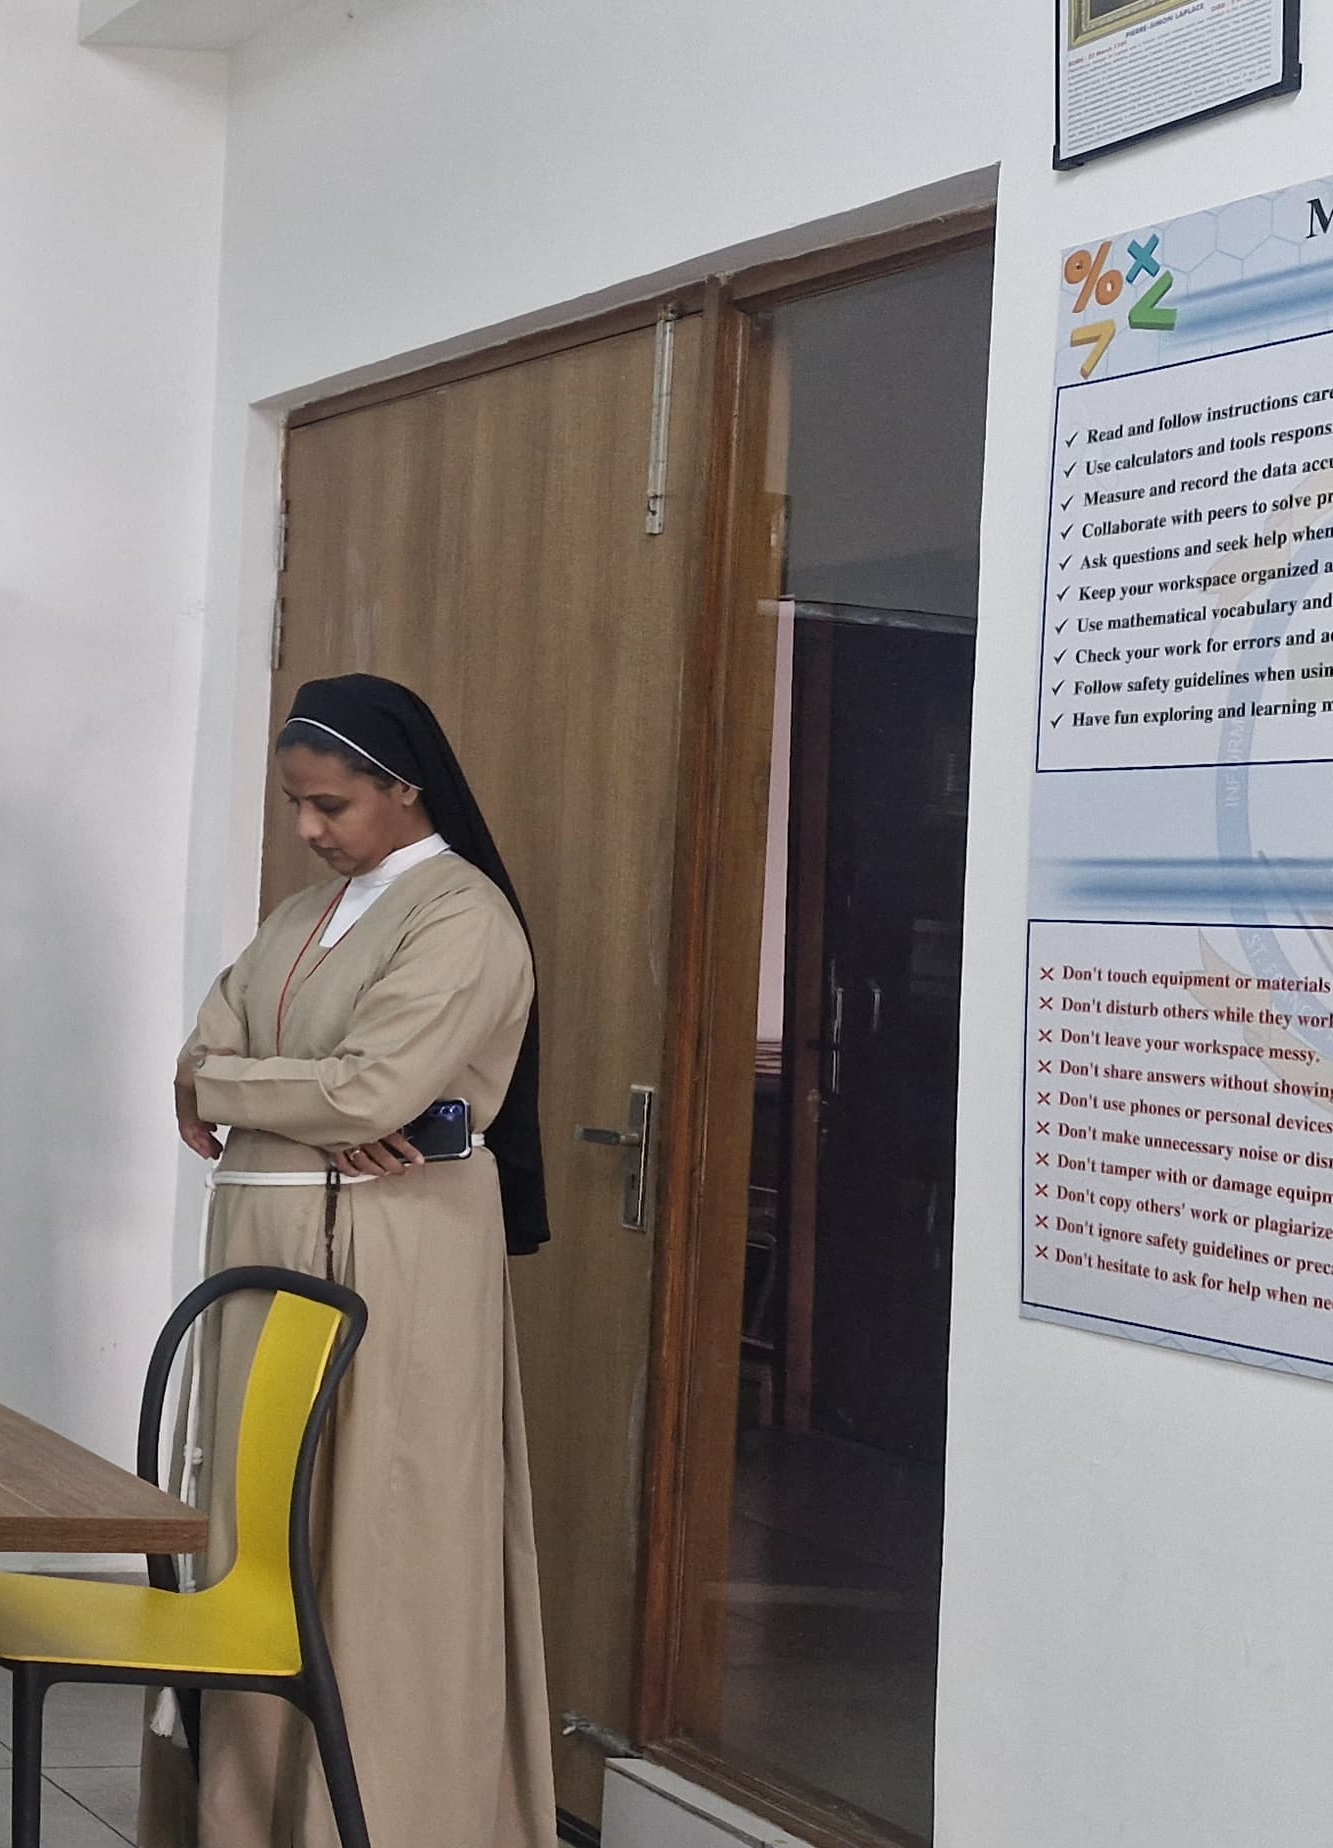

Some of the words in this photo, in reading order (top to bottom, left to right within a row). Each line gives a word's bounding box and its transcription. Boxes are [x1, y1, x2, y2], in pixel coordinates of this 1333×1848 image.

[1086, 424, 1124, 445] Read
[1127, 417, 1155, 437] and
[1157, 412, 1203, 432] follow
[1206, 394, 1299, 423] instructions
[1085, 459, 1112, 476] Use
[1114, 447, 1194, 471] calculators
[1196, 437, 1226, 457] and
[1229, 431, 1267, 452] tools
[1083, 488, 1146, 507] Measure
[1148, 478, 1176, 498] and
[1180, 470, 1229, 493] record
[1233, 467, 1258, 484] the
[1261, 461, 1298, 479] data
[1081, 515, 1167, 539] Collaborate
[1170, 507, 1203, 526] with
[1207, 504, 1248, 526] peers
[1251, 499, 1268, 515] to
[1270, 493, 1312, 513] solve
[1079, 553, 1108, 570] Ask
[1112, 546, 1181, 570] questions
[1183, 538, 1212, 558] and
[1215, 534, 1249, 553] seek
[1252, 529, 1288, 550] help
[1078, 585, 1117, 603] Keep
[1120, 583, 1155, 601] your
[1157, 573, 1237, 593] workspace
[1240, 558, 1319, 586] organized
[1076, 617, 1104, 633] Use
[1107, 605, 1207, 630] mathematical
[1211, 598, 1298, 620] vocabulary
[1075, 647, 1122, 664] Check
[1125, 646, 1161, 665] your
[1164, 640, 1202, 657] work
[1206, 637, 1230, 654] for
[1232, 635, 1282, 651] errors
[1285, 628, 1316, 647] and
[1073, 679, 1123, 696] Follow
[1126, 675, 1171, 694] safety
[1174, 669, 1250, 693] guidelines
[1254, 665, 1296, 683] when
[1071, 711, 1111, 728] Have
[1113, 709, 1139, 725] fun
[1142, 704, 1214, 727] exploring
[1217, 702, 1246, 719] and
[1250, 698, 1318, 718] learning
[1062, 965, 1103, 982] Don't
[1107, 968, 1148, 984] touch
[1151, 971, 1231, 990] equipment
[1234, 977, 1253, 990] or
[1256, 976, 1332, 994] materials
[1061, 996, 1102, 1014] Don't
[1105, 999, 1159, 1017] disturb
[1162, 1003, 1210, 1020] others
[1212, 1006, 1255, 1023] while
[1258, 1008, 1293, 1030] they
[1060, 1028, 1101, 1046] Don't
[1104, 1031, 1142, 1049] leave
[1145, 1038, 1181, 1053] your
[1183, 1039, 1265, 1060] workspace
[1268, 1047, 1321, 1066] messy.
[1059, 1059, 1100, 1077] Don't
[1102, 1064, 1143, 1081] share
[1146, 1071, 1206, 1087] answers
[1209, 1073, 1269, 1093] without
[1059, 1091, 1099, 1109] Don't
[1102, 1099, 1126, 1112] use
[1130, 1098, 1181, 1118] phones
[1184, 1108, 1202, 1120] or
[1205, 1110, 1271, 1128] personal
[1058, 1122, 1097, 1141] Don't
[1101, 1129, 1141, 1146] make
[1144, 1136, 1234, 1161] unnecessary
[1238, 1144, 1279, 1162] noise
[1282, 1152, 1302, 1165] or
[1057, 1153, 1097, 1173] Don't
[1100, 1160, 1153, 1182] tamper
[1155, 1167, 1188, 1185] with
[1191, 1175, 1209, 1188] or
[1212, 1174, 1273, 1199] damage
[1056, 1184, 1096, 1205] Don't
[1098, 1195, 1132, 1214] copy
[1135, 1198, 1186, 1218] others'
[1190, 1207, 1229, 1224] work
[1232, 1214, 1251, 1228] or
[1055, 1216, 1094, 1236] Don't
[1097, 1222, 1143, 1244] ignore
[1145, 1232, 1189, 1256] safety
[1192, 1240, 1270, 1265] guidelines
[1273, 1255, 1292, 1269] or
[1054, 1247, 1093, 1269] Don't
[1096, 1254, 1151, 1279] hesitate
[1154, 1266, 1169, 1282] to
[1172, 1270, 1198, 1287] ask
[1201, 1272, 1225, 1292] for
[1227, 1276, 1262, 1302] help
[1265, 1285, 1308, 1307] when
